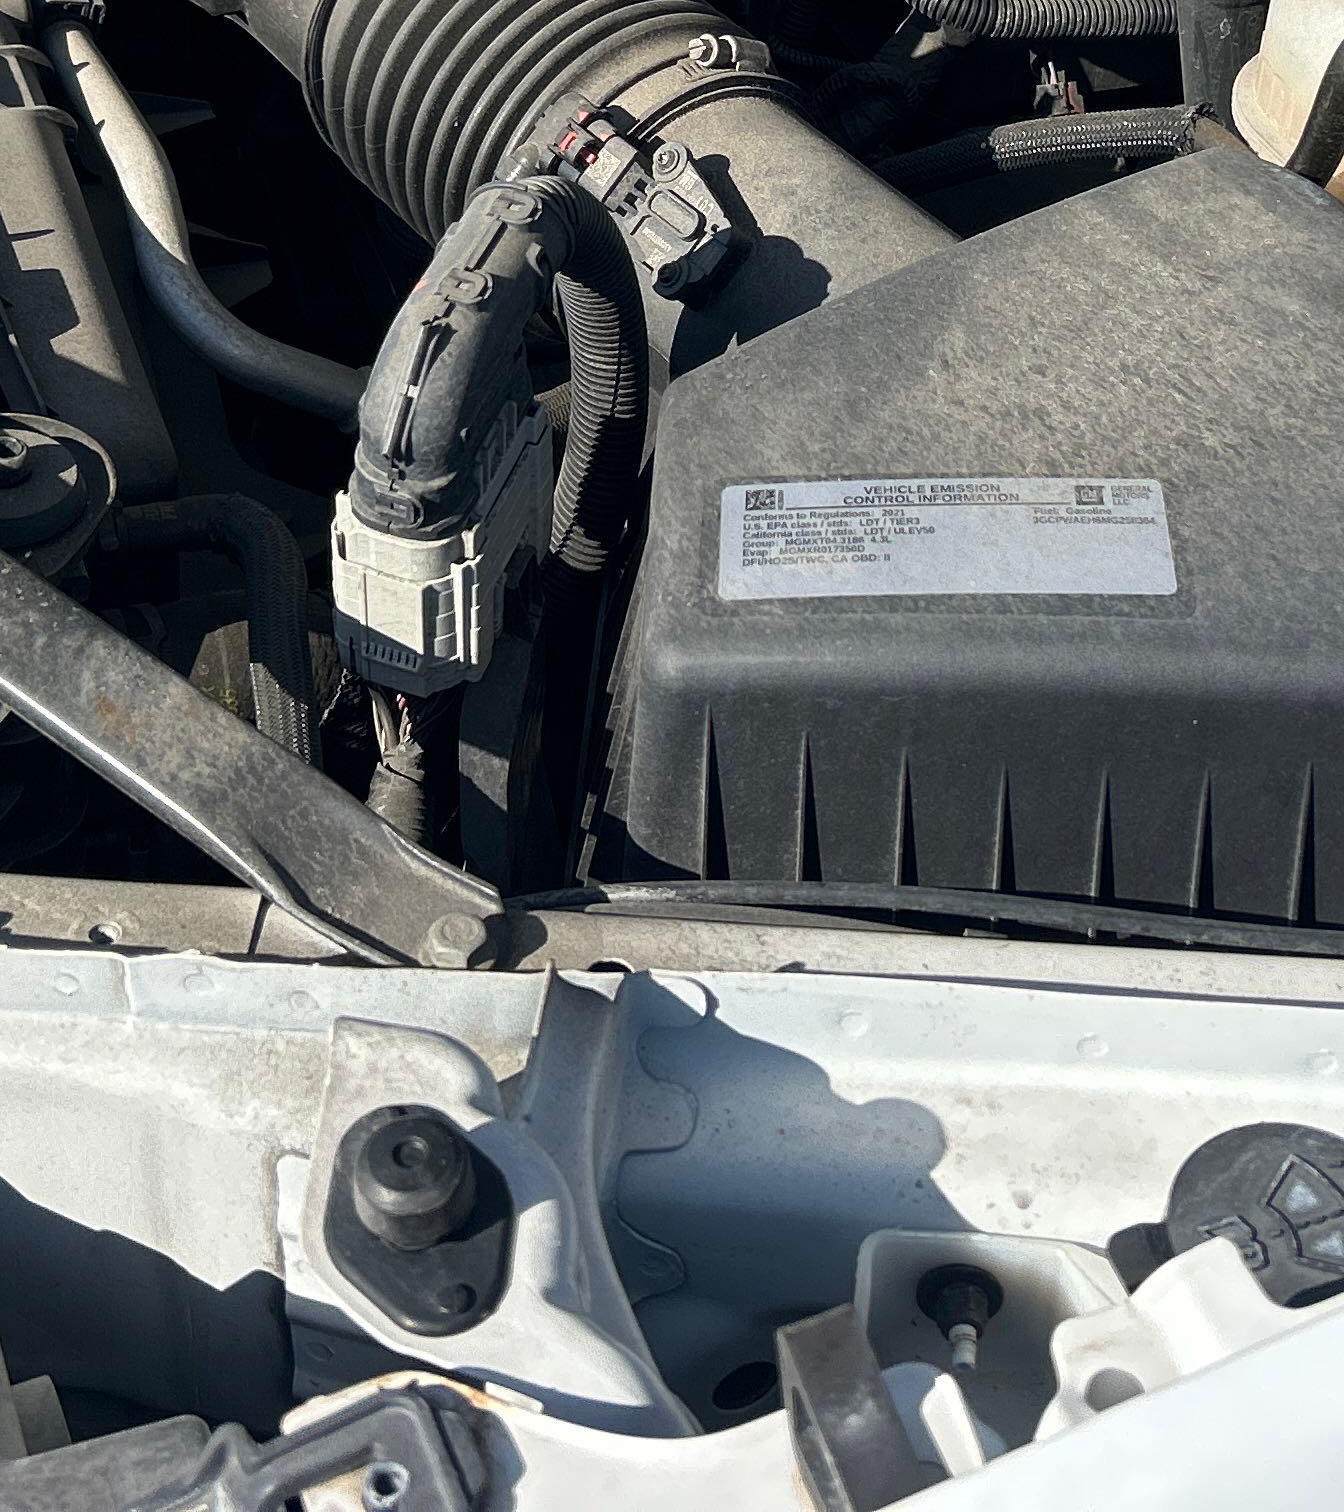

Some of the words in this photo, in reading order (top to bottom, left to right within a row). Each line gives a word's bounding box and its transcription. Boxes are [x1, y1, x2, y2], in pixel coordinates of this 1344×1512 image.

[863, 484, 926, 495] VEHICLE
[930, 483, 1001, 494] EMISSION
[843, 494, 914, 505] CONTROL
[918, 493, 1020, 504] INFORMATION
[743, 513, 794, 522] Conforms
[796, 512, 806, 520] to
[809, 510, 874, 521] Regulations:
[881, 509, 905, 517] 2021
[1065, 507, 1112, 515] Gasoline
[743, 522, 763, 531] U.S.
[766, 521, 788, 530] EPA
[790, 520, 818, 529] class
[859, 518, 879, 527] LDT
[890, 517, 920, 526] TIER3
[743, 529, 793, 539] California
[795, 529, 822, 538] class
[863, 527, 884, 536] LDT
[743, 548, 771, 558] Evap:
[831, 555, 849, 564] CA
